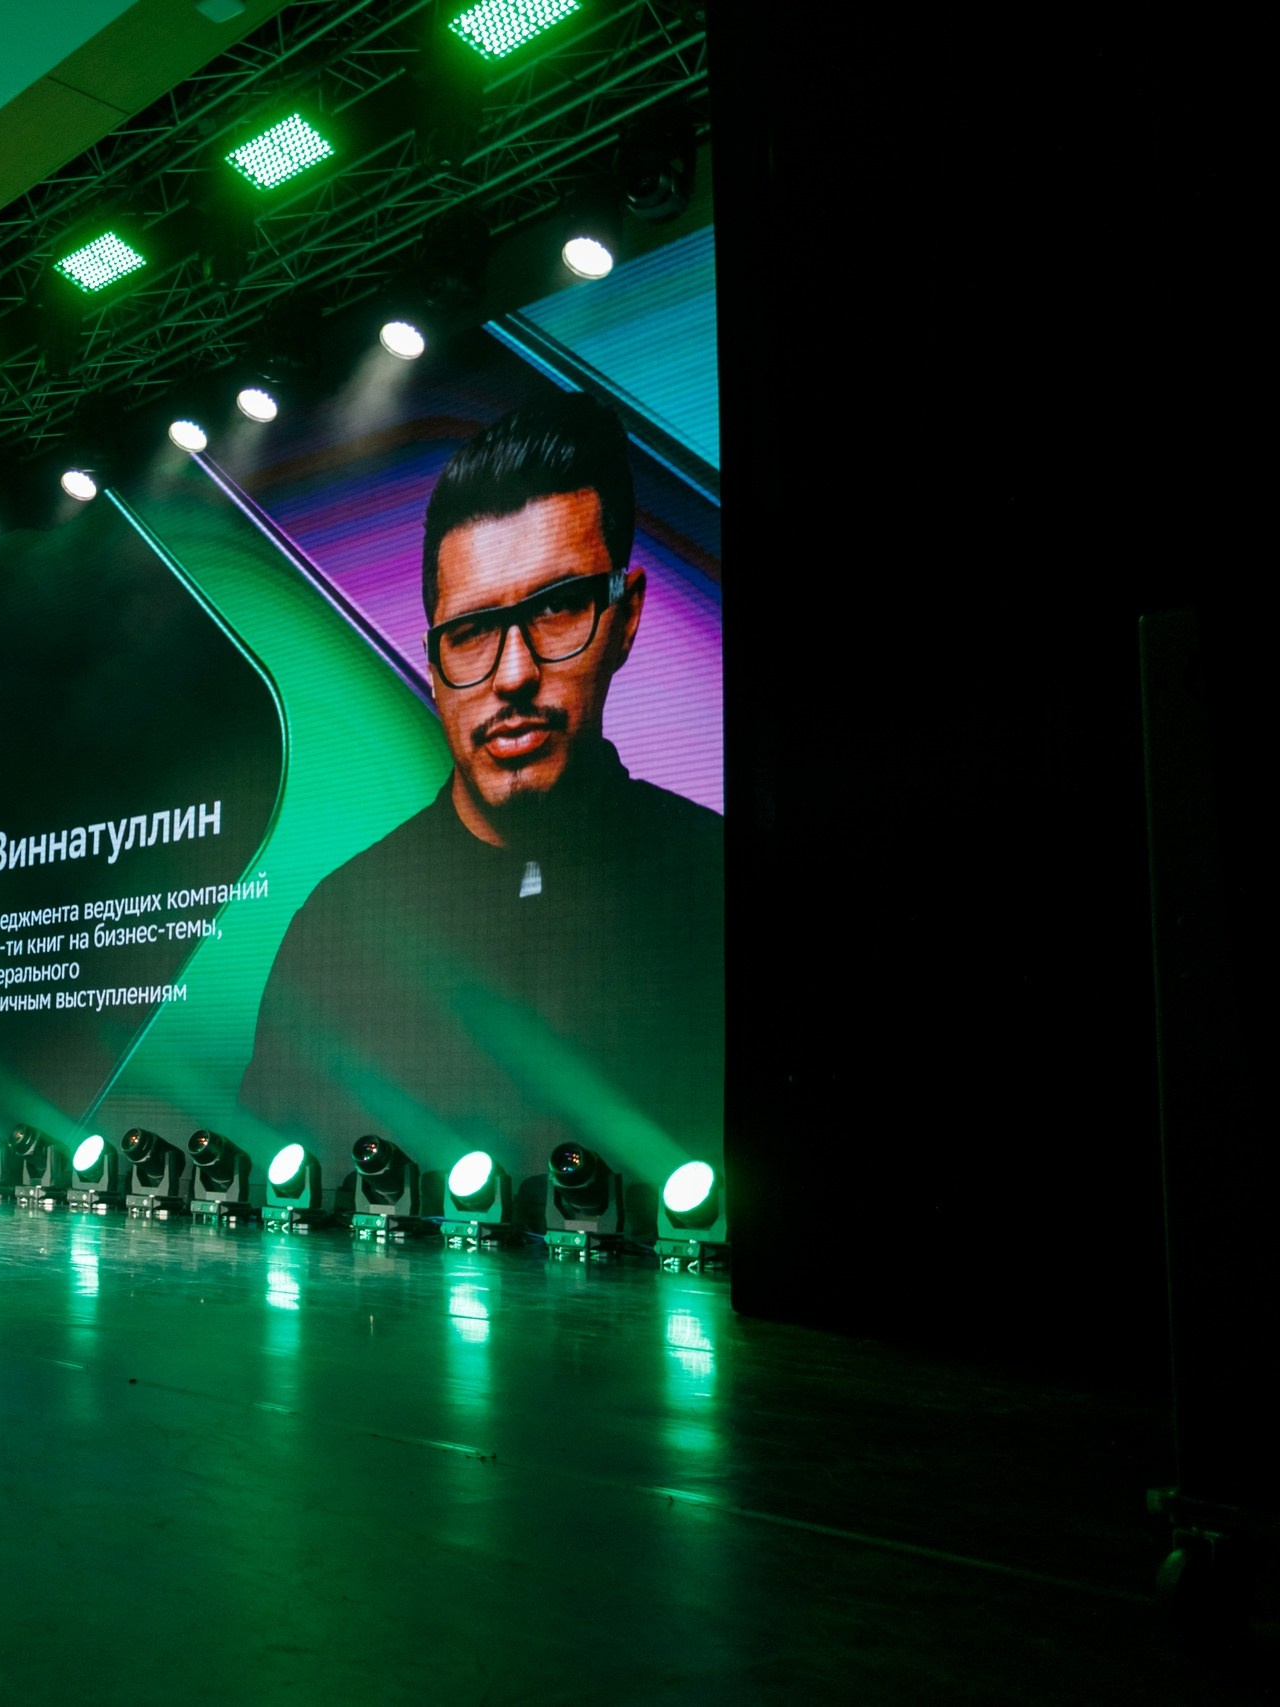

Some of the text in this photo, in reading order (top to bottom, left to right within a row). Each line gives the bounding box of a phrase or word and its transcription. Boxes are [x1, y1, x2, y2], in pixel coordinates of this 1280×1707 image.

[84, 894, 161, 921] ведущих
[168, 872, 268, 909] компаний
[28, 936, 64, 954] книг
[70, 933, 88, 950] на
[94, 919, 222, 947] бизнес-темы,
[56, 985, 186, 1012] выступлениям
